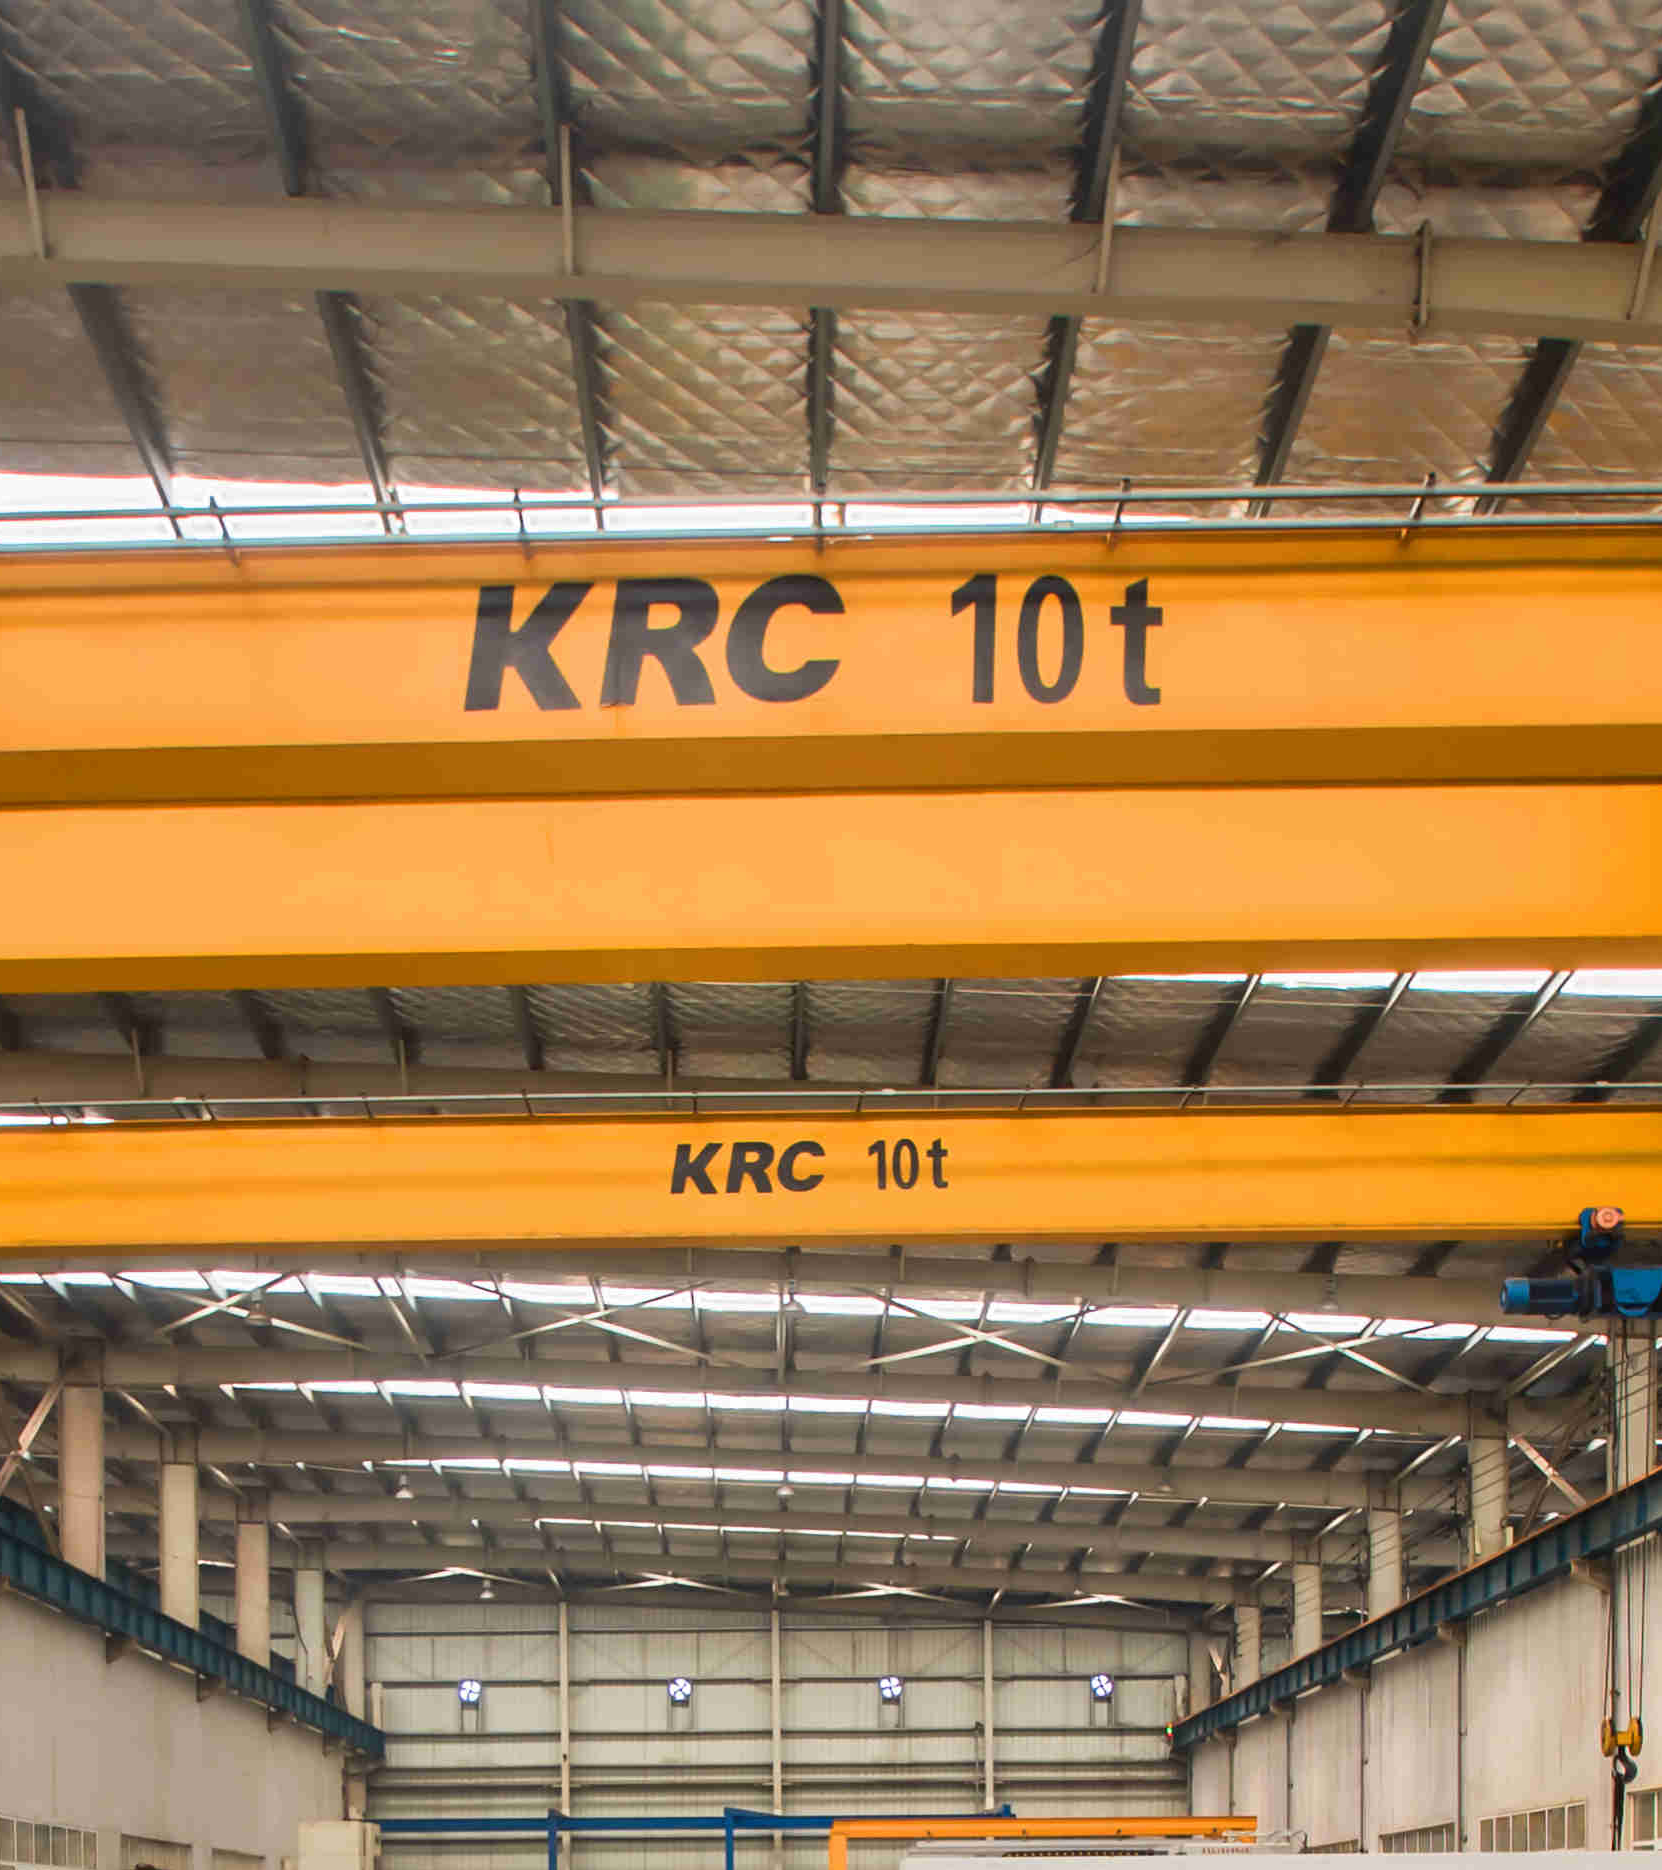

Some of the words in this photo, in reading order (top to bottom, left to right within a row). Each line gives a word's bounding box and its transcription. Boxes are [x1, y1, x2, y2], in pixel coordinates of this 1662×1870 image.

[465, 573, 846, 710] KRC
[950, 572, 1164, 705] 10t
[670, 1140, 826, 1194] KRC
[867, 1138, 949, 1190] 10t
